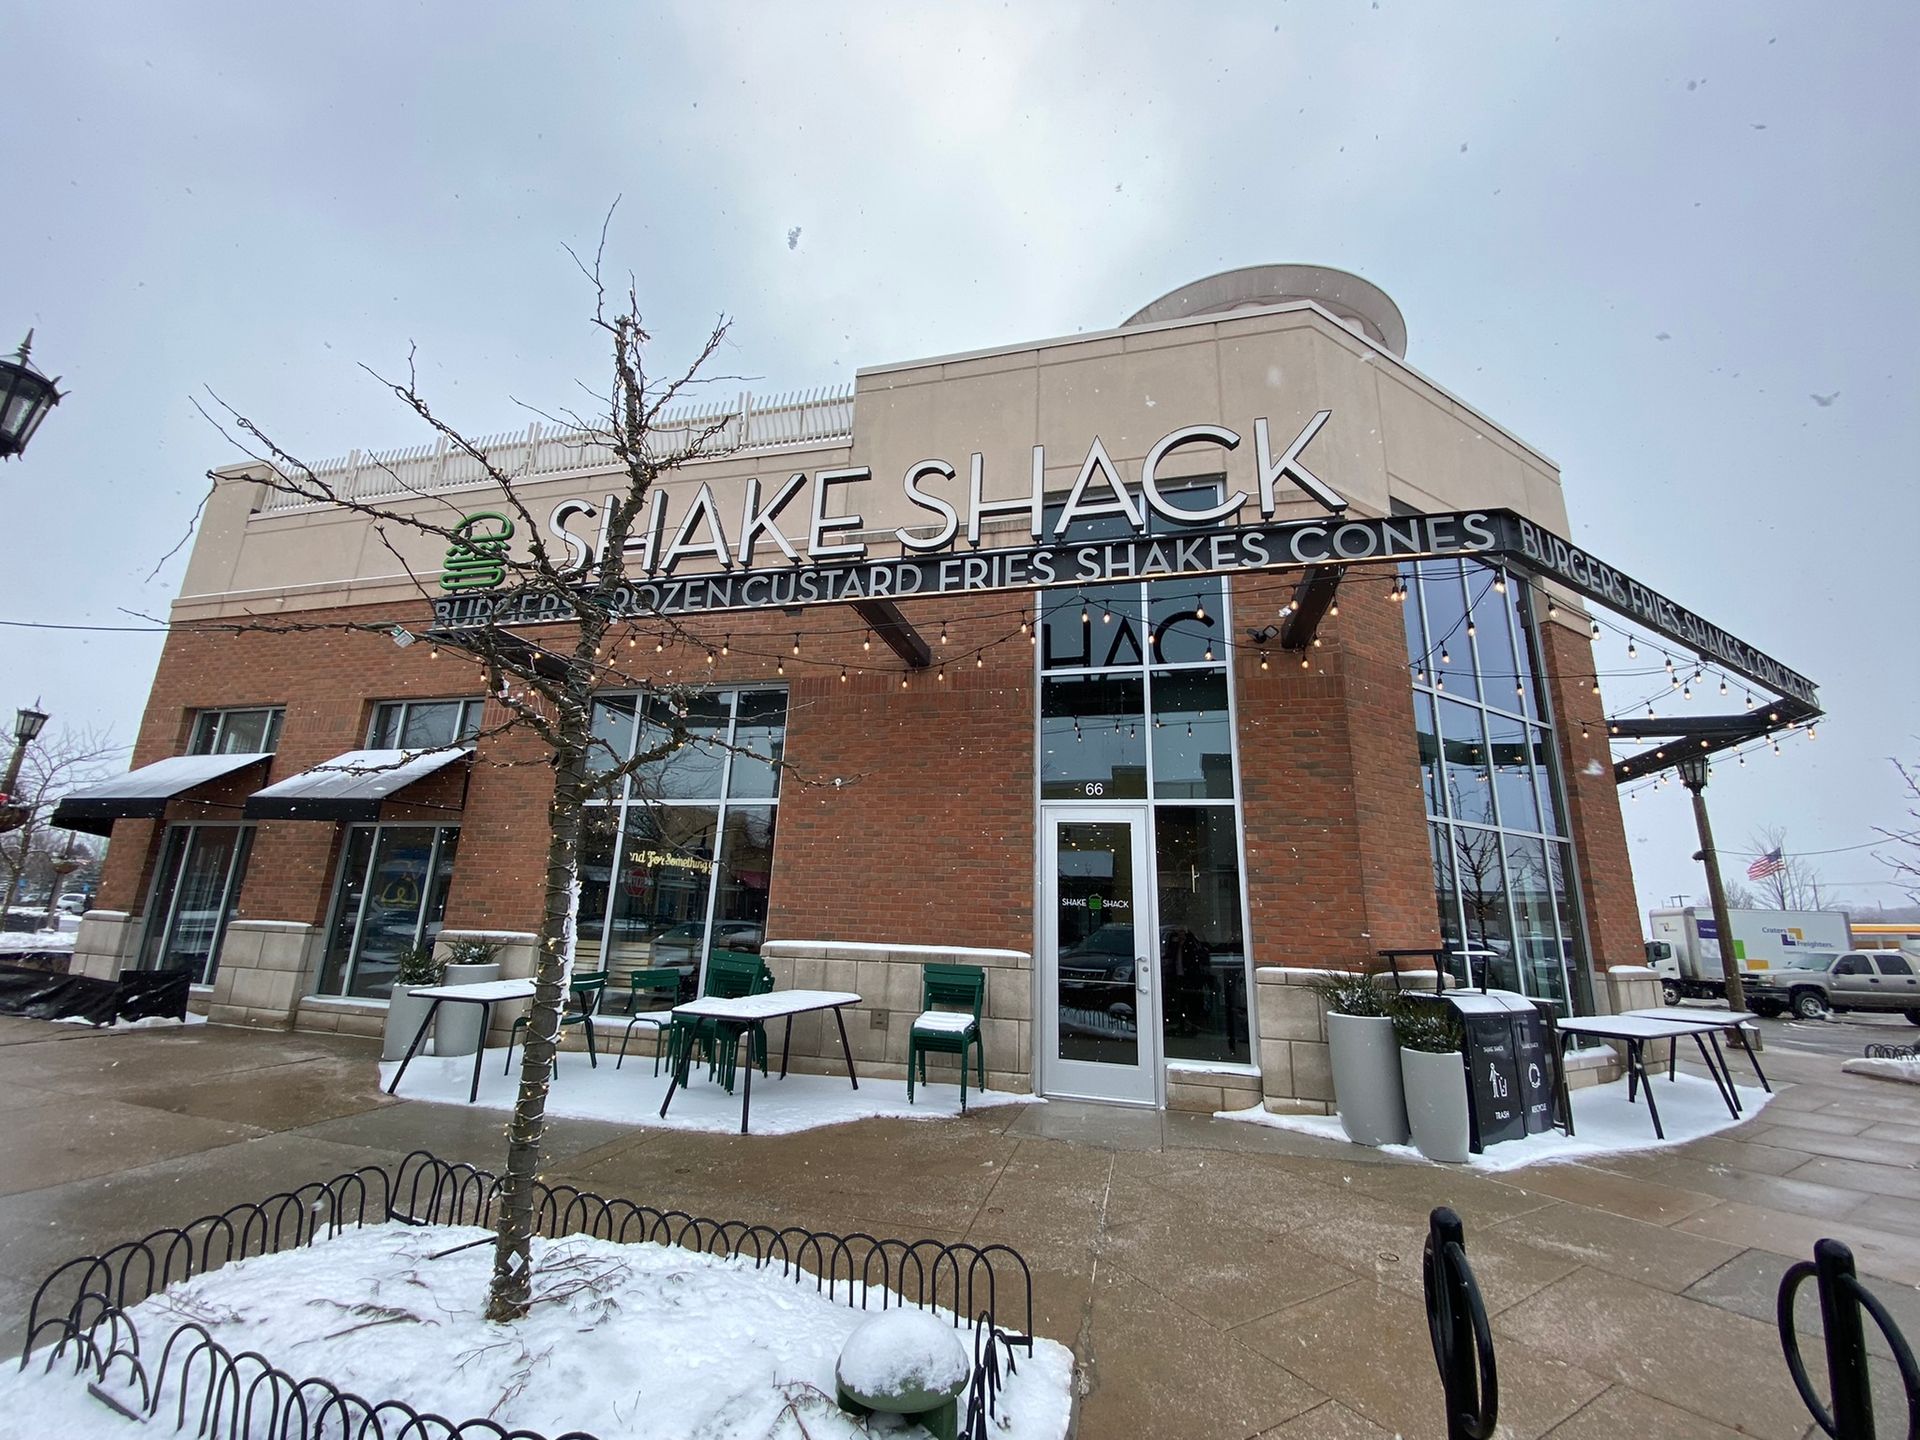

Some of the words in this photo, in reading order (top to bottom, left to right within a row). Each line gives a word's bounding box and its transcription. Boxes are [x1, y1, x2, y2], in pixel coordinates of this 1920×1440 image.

[549, 466, 871, 576] SHAKE
[894, 409, 1349, 552] SHACK
[610, 577, 733, 616] ROZEN
[742, 564, 922, 606] CUSTARD
[938, 552, 1056, 592] FRIES
[1075, 532, 1266, 583] SHAKES
[1290, 513, 1497, 564] CONES
[1518, 518, 1627, 605] BURGERS
[1628, 580, 1682, 635] FRIES
[1683, 611, 1745, 668] SHAKES
[1085, 782, 1104, 796] 66
[1061, 897, 1087, 907] SHAKE
[1102, 899, 1129, 909] SHACK
[1761, 926, 1788, 934] Craters
[1495, 1110, 1510, 1119] TRASH
